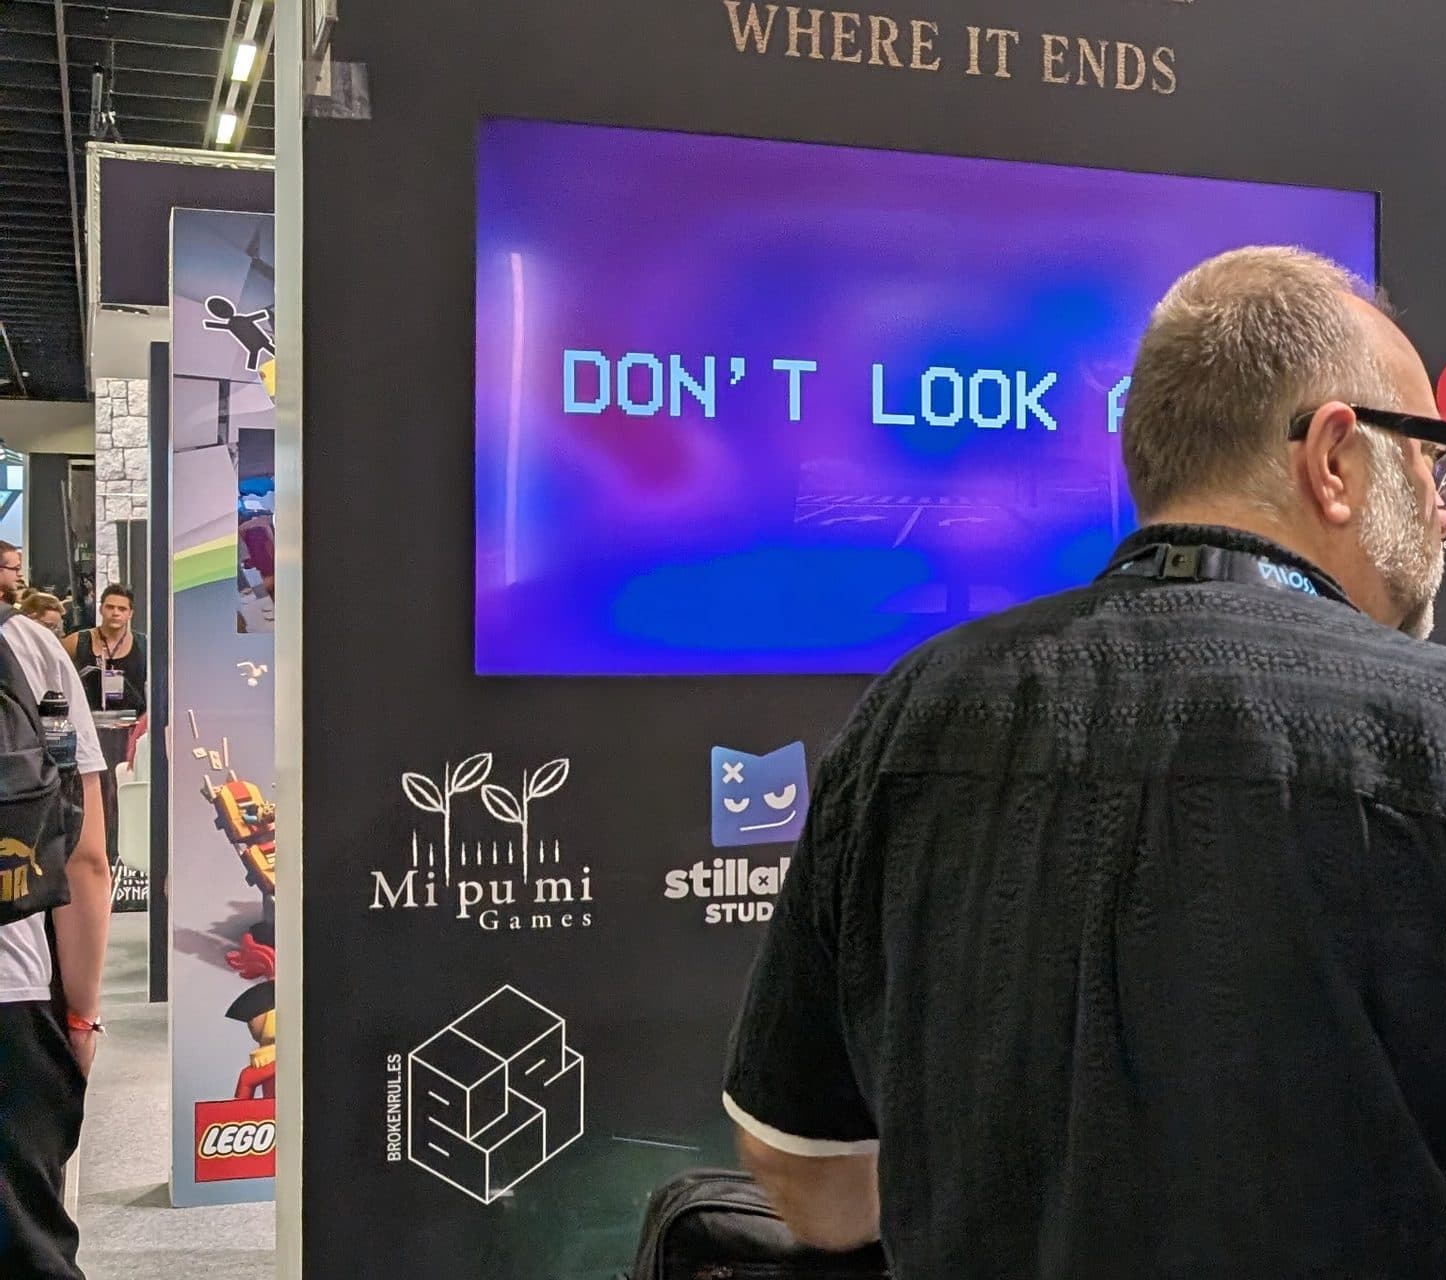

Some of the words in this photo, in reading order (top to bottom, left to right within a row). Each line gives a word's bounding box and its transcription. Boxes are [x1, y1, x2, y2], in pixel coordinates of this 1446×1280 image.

[723, 0, 942, 73] WHERE
[966, 26, 1019, 80] IT
[1042, 35, 1177, 95] ENDS
[873, 363, 1057, 432] LOOK
[479, 910, 592, 931] Games
[200, 1123, 275, 1157] LEGO
